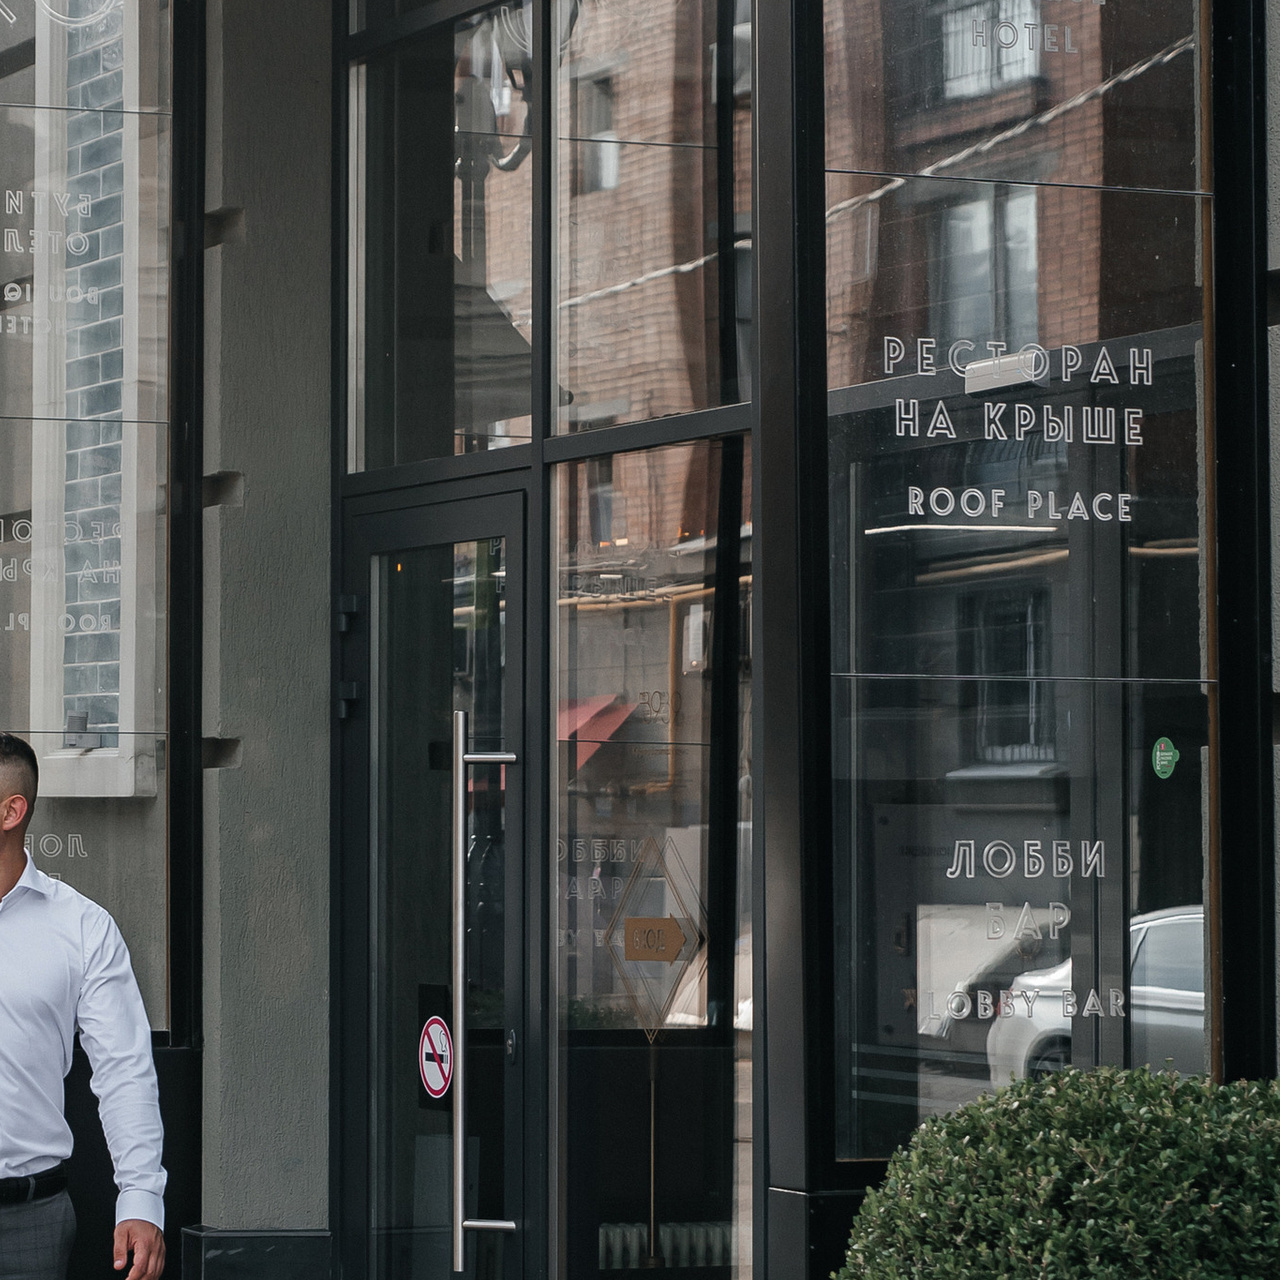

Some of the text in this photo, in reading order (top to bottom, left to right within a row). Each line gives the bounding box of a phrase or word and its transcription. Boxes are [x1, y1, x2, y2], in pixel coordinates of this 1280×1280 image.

[971, 19, 1079, 54] HOTEL
[882, 335, 1153, 385] РЕСТОРАН
[894, 398, 1144, 446] НА КРЫШЕ
[907, 486, 1132, 522] ROOF PLACE
[945, 839, 1106, 878] ЛОББИ
[985, 901, 1072, 940] БАР
[927, 987, 1126, 1021] LOBBY BAR
